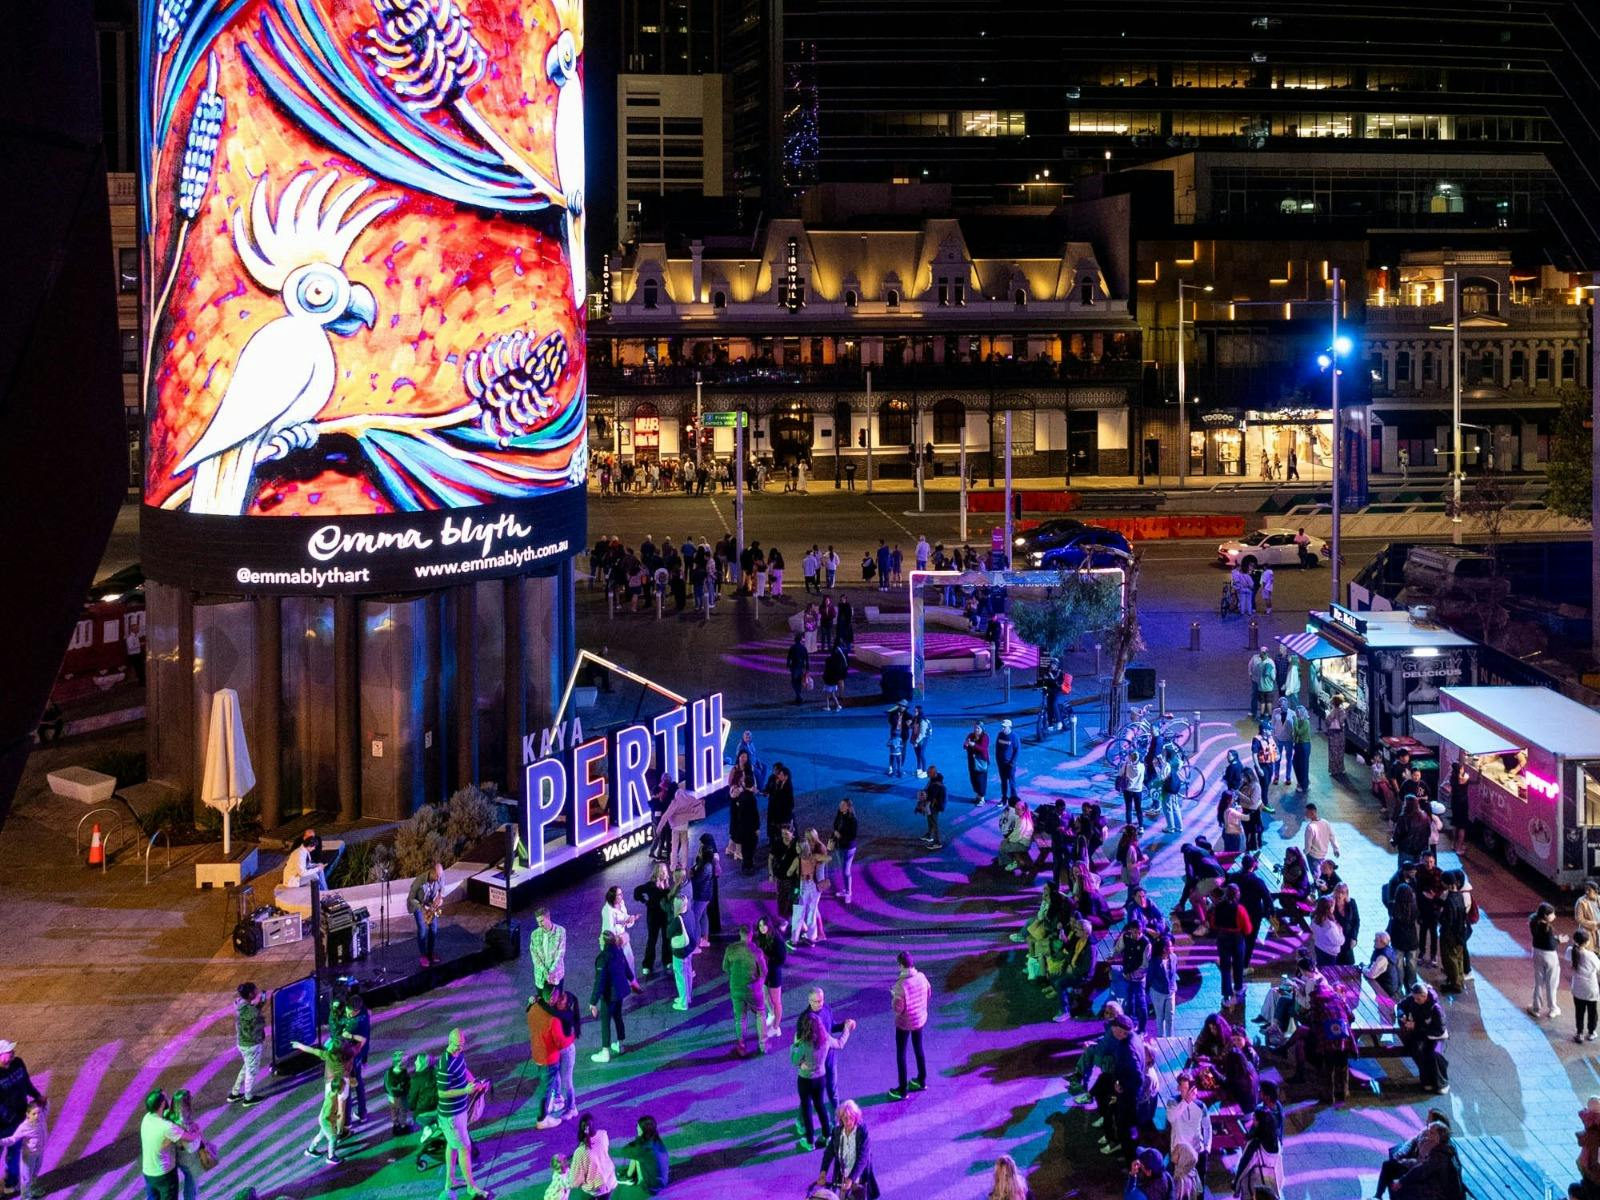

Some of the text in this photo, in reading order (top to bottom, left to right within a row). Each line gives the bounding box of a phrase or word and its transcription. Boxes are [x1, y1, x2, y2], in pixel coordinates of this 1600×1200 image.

[790, 256, 798, 299] ROYAL
[440, 514, 532, 558] blyth
[236, 567, 370, 588] @emmablythart
[415, 540, 569, 578] www.emmablyth.com.au
[1402, 668, 1462, 678] DELICIOUS
[522, 717, 584, 765] KAYA
[526, 692, 723, 869] PERTH
[603, 830, 646, 861] YAGAN
